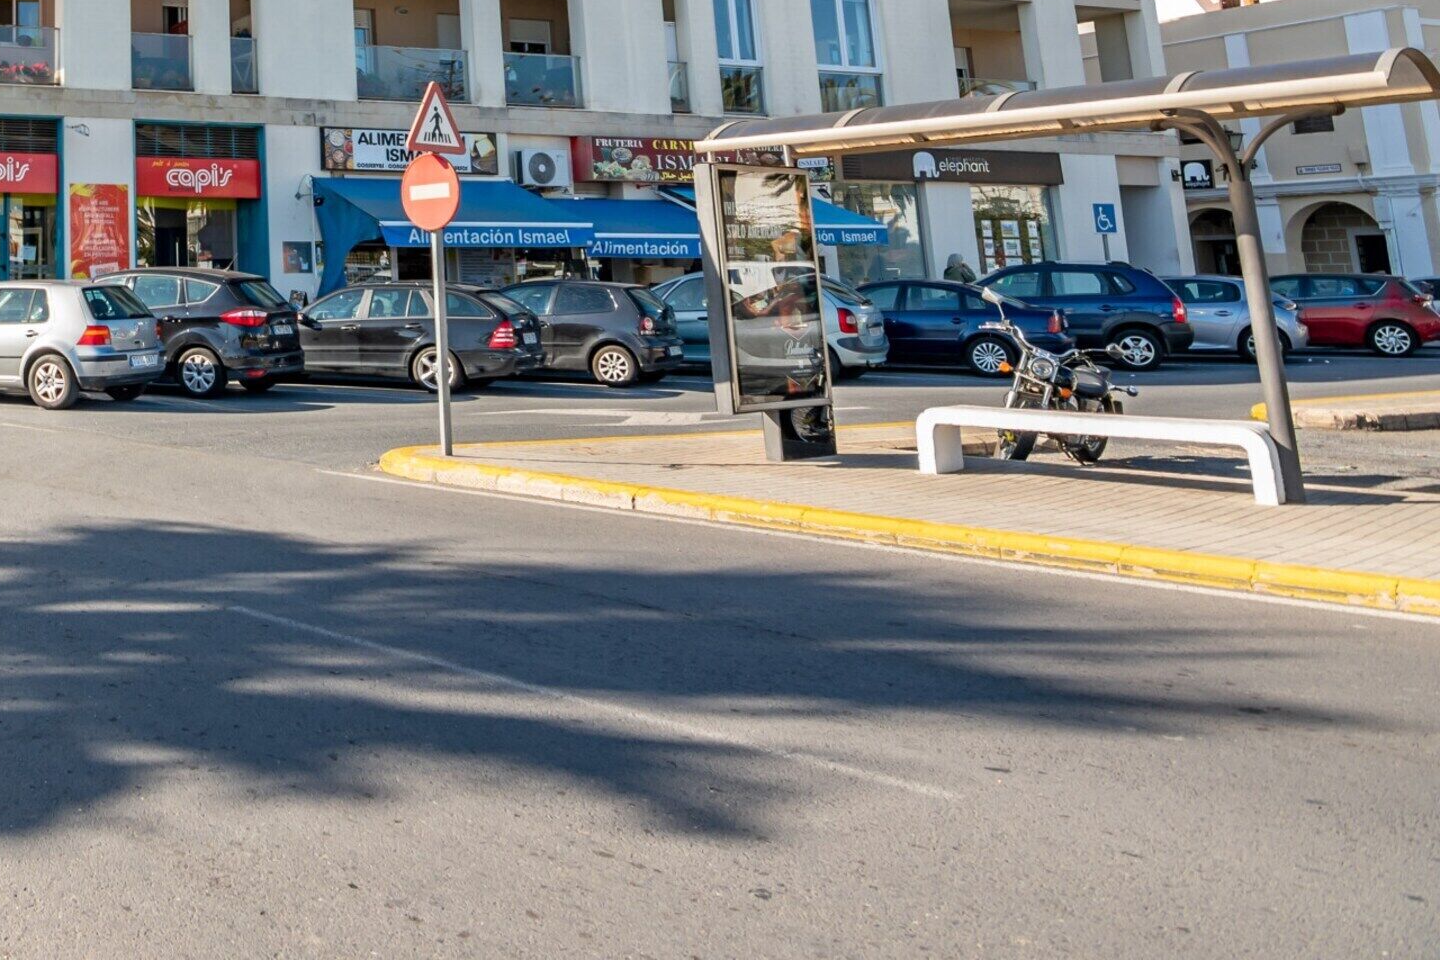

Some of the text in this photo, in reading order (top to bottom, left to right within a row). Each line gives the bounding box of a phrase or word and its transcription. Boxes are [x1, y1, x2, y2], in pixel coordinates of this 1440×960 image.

[595, 138, 643, 148] FRUTERIA
[652, 139, 695, 150] CARNI
[938, 157, 990, 175] elephant
[165, 163, 233, 193] capi's
[409, 228, 571, 244] Alientación Ismael
[841, 230, 877, 242] Ismael
